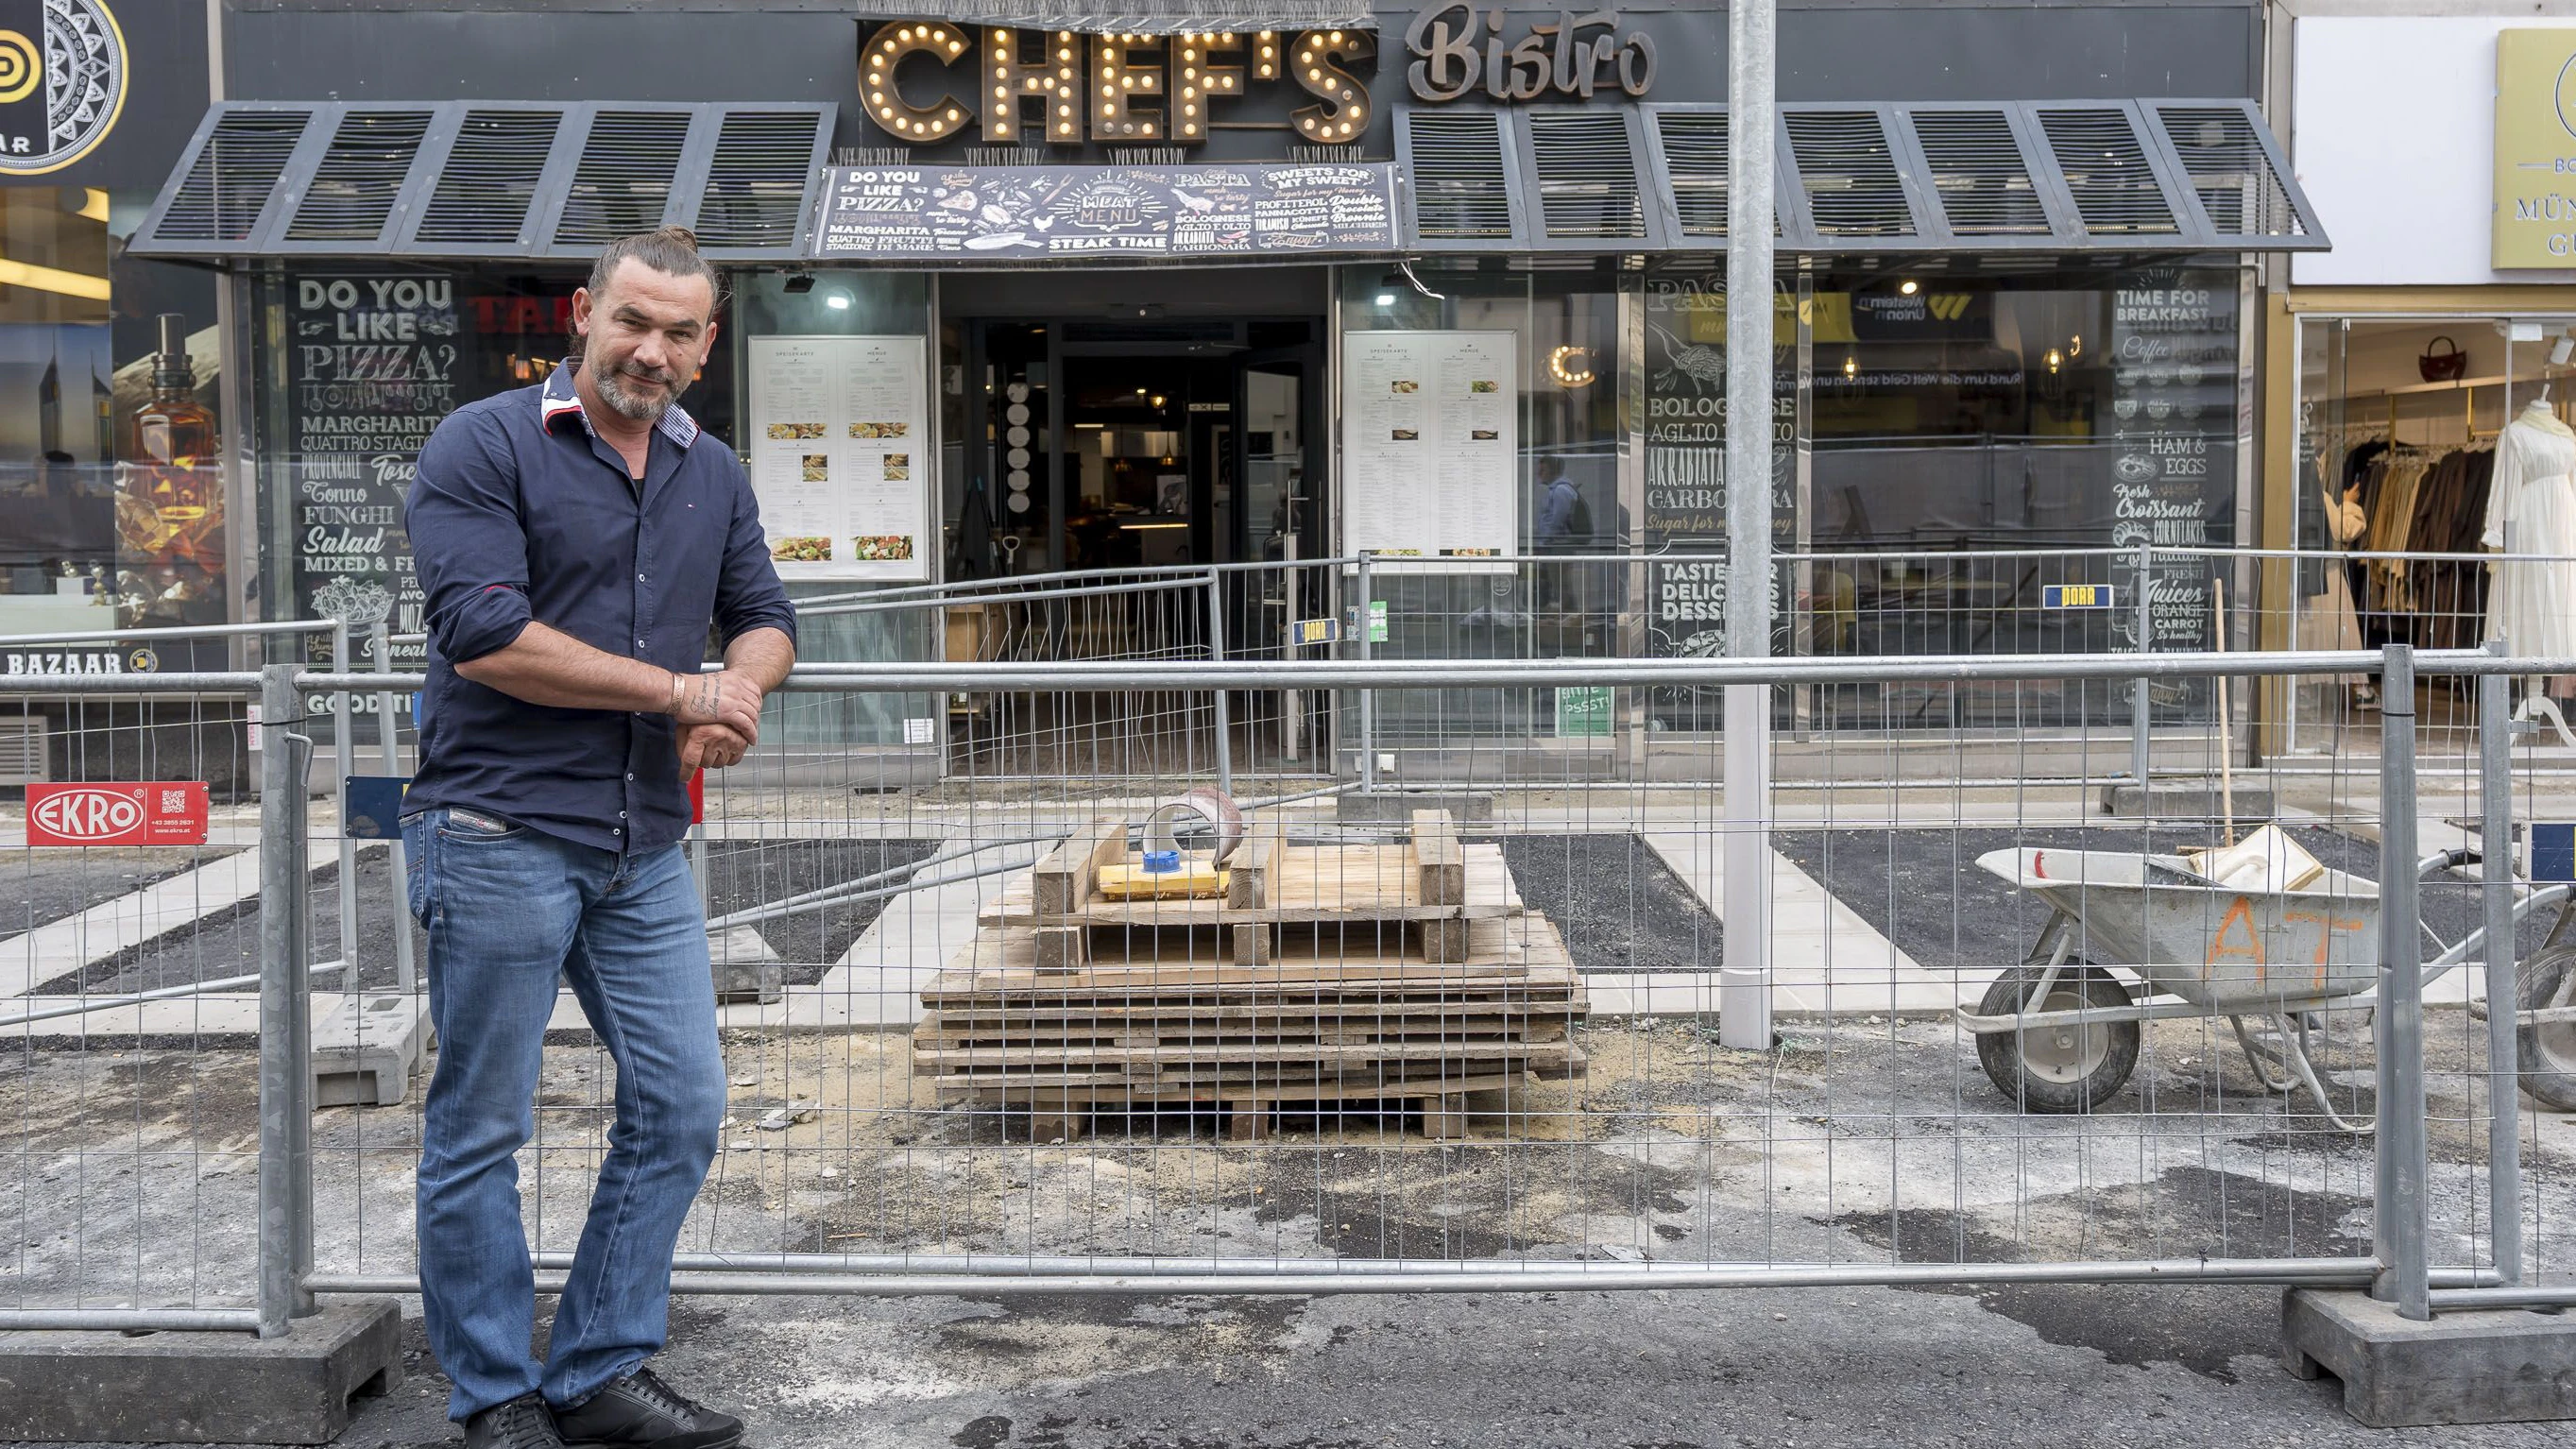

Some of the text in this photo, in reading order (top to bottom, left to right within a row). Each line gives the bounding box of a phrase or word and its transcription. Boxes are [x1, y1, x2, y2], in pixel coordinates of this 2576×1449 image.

[1405, 3, 1658, 101] Bistro
[857, 20, 1376, 144] CHEF'S
[849, 171, 920, 183] DO YOU
[1174, 173, 1252, 187] PASTA
[1267, 167, 1370, 181] SWEETS FOR
[862, 184, 904, 196] LIKE
[1277, 176, 1363, 189] MY SWEET
[1082, 196, 1139, 209] MEAT
[1254, 195, 1384, 210] PROFITEROL Double
[1273, 189, 1303, 200] Sugar
[1303, 189, 1318, 198] for
[836, 196, 925, 213] PIZZA?
[1254, 204, 1386, 217] PANNACOTTA Chocolate
[2515, 193, 2576, 221] MÜN
[1080, 209, 1137, 223] MENU
[1174, 214, 1253, 224] BOLOGNESE
[1330, 213, 1387, 224] Brownie
[828, 225, 930, 235] MARGHARITA
[1174, 223, 1212, 231] AGLIO
[1221, 222, 1252, 230] OLIO
[827, 235, 876, 245] QUATTRO
[877, 236, 934, 245] FRUTTI
[1049, 236, 1168, 249] STEAK TIME
[1171, 243, 1252, 251] CARBONARA
[299, 280, 452, 310] DO YOU
[2117, 290, 2209, 305] TIME FOR
[2117, 308, 2210, 321] BREAKFAST
[337, 313, 417, 341] LIKE
[2123, 335, 2169, 364] Coffee
[298, 345, 456, 382] PIZZA?
[300, 416, 447, 434] MARGHARIT
[300, 435, 369, 452] QUATTRO
[2149, 438, 2206, 454] HAM &
[301, 453, 418, 486] PROVENCIALE Tosc
[1647, 447, 1724, 486] ARRABIATA
[2165, 458, 2207, 475] EGGS
[301, 481, 367, 503] Tonno
[2113, 483, 2153, 499] Fresh
[302, 505, 396, 525] FUNGHI
[2115, 498, 2206, 519] Croissant
[1646, 514, 1689, 537] Sugar
[1691, 515, 1714, 535] for
[2154, 520, 2207, 544] CORNFLAKES
[302, 526, 385, 554] Salad
[304, 556, 369, 572] MIXED
[374, 558, 388, 572] &
[2152, 605, 2205, 617] ORANGE
[2155, 620, 2204, 629] CARROT
[2169, 630, 2203, 644] healthy
[7, 653, 122, 674] BAZAAR
[392, 694, 412, 714] TI
[38, 793, 136, 835] EKRO
